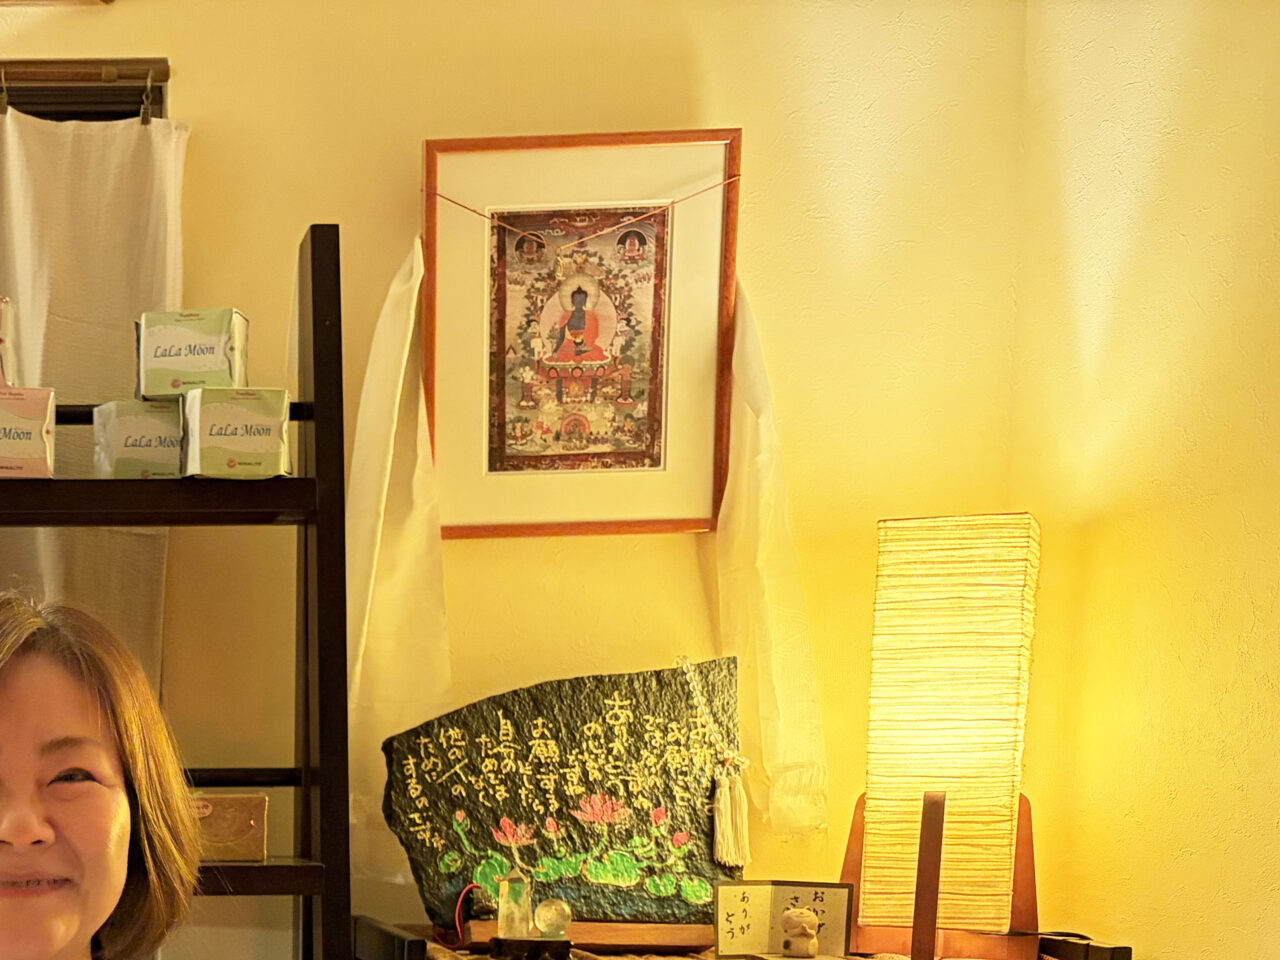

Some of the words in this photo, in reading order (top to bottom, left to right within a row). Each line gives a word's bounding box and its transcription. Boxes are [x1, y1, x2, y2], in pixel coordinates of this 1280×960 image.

[153, 344, 182, 358] LaLa
[209, 423, 238, 437] LaLa
[124, 435, 152, 448] LaLa
